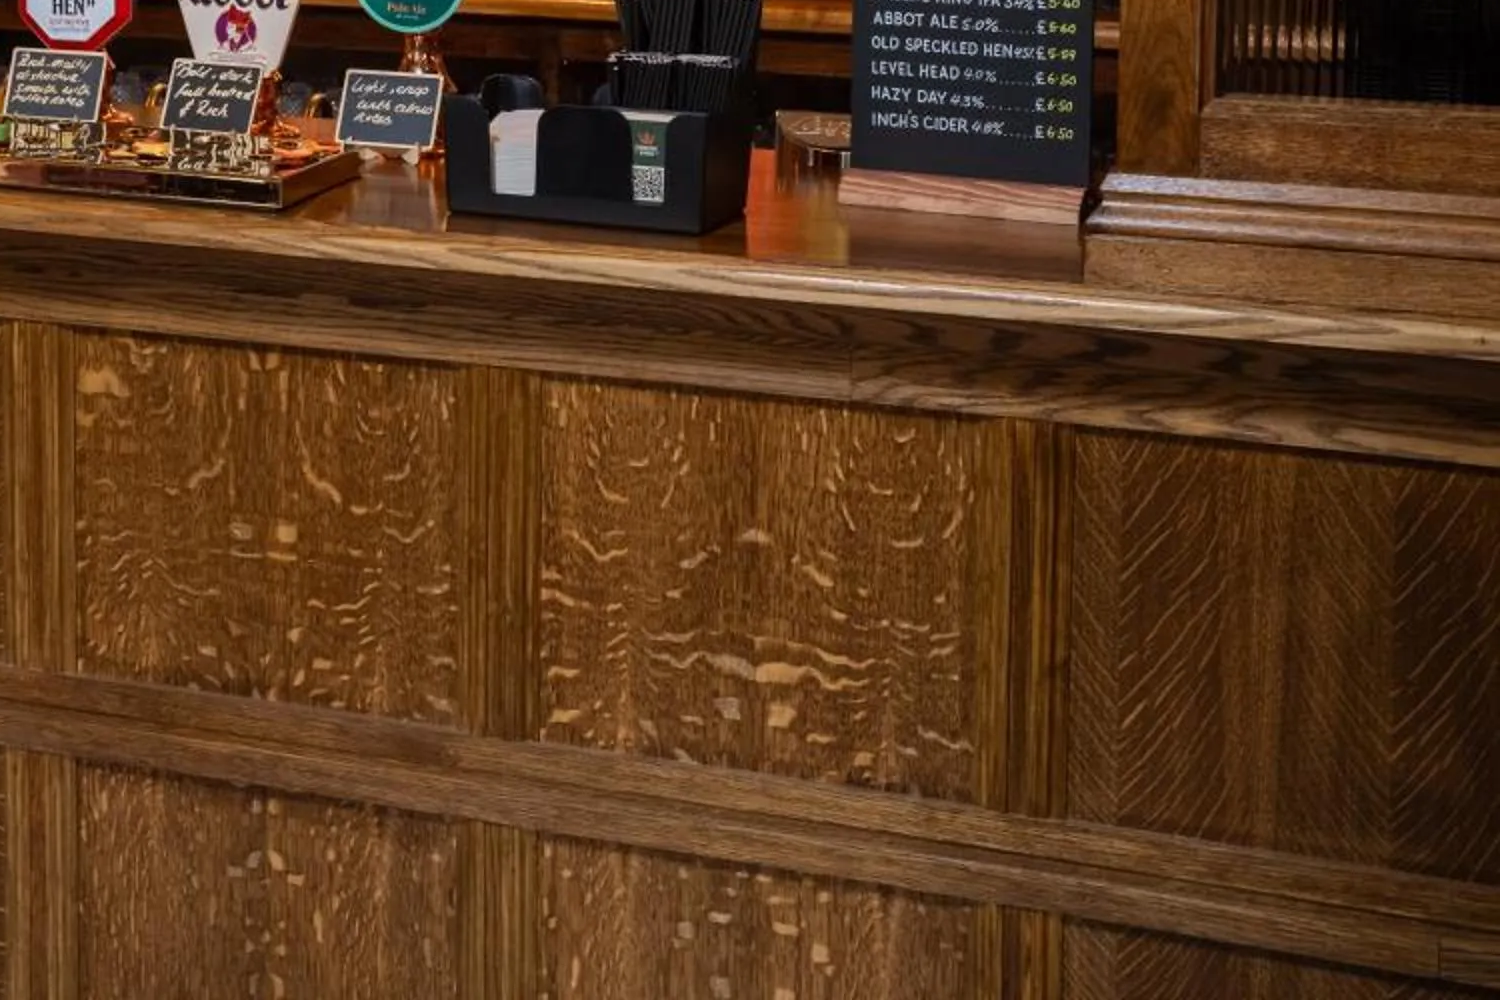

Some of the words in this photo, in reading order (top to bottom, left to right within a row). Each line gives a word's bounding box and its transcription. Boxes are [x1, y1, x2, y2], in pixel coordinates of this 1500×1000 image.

[873, 11, 924, 28] ABBOT
[929, 13, 959, 29] ALE
[871, 35, 900, 50] OLD
[905, 37, 979, 57] SPECKLED
[983, 42, 1013, 58] HEN
[871, 61, 914, 77] LEVEL
[919, 64, 960, 80] HEAD
[871, 85, 911, 102] HAZY
[917, 88, 948, 105] DAY
[871, 109, 919, 130] INCH'S
[923, 115, 969, 135] CIDER
